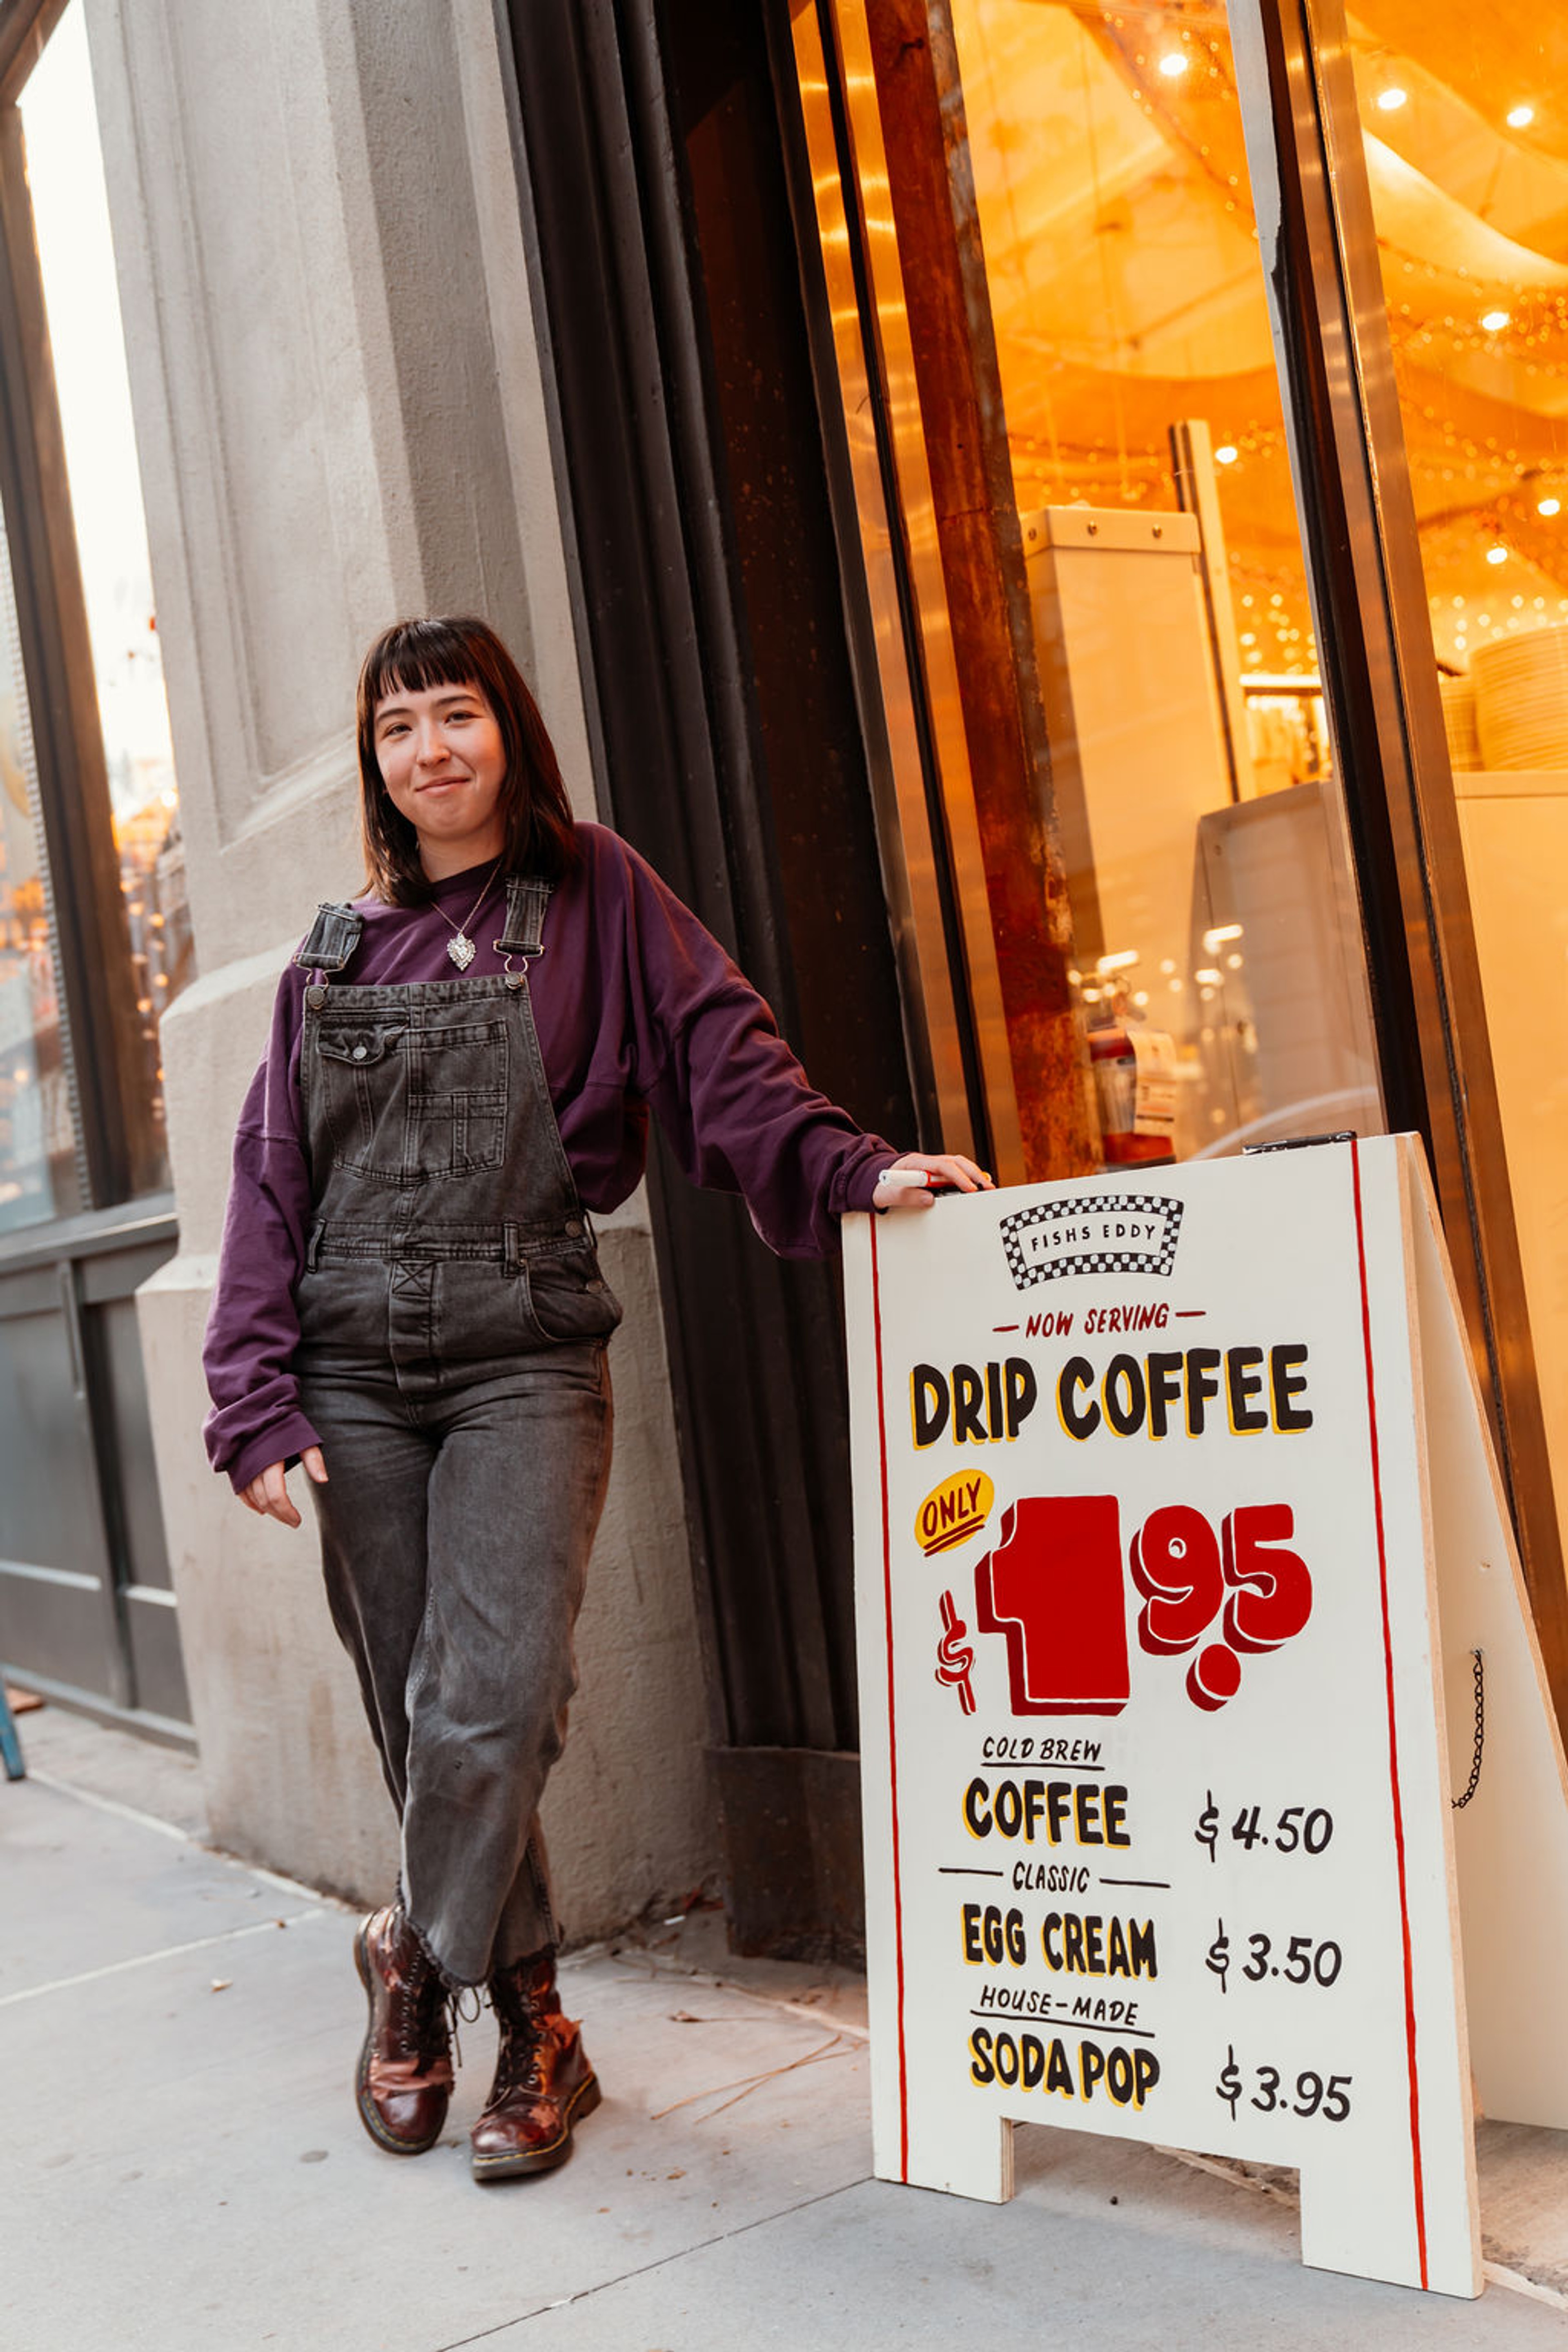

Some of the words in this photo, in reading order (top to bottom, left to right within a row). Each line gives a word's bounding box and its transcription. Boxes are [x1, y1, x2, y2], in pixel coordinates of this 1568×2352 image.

[1031, 1225, 1091, 1252] FISHS
[1102, 1223, 1156, 1240] EDDY
[1025, 1310, 1074, 1339] NOW
[1083, 1302, 1170, 1335] SERVING
[909, 1356, 1038, 1451] DRIP
[1055, 1343, 1313, 1443] COFFEE
[922, 1477, 981, 1537] ONLY
[982, 1736, 1034, 1760] COLD
[1039, 1737, 1102, 1763] BREW
[961, 1777, 1131, 1850] COFFEE
[1012, 1860, 1091, 1894] CLASSIC
[960, 1903, 1027, 1969] EGG
[1040, 1912, 1158, 1982] CREAM
[980, 1984, 1139, 2027] HOUSE-MADE
[967, 2027, 1075, 2100] SODA
[1078, 2040, 1160, 2111] POP
